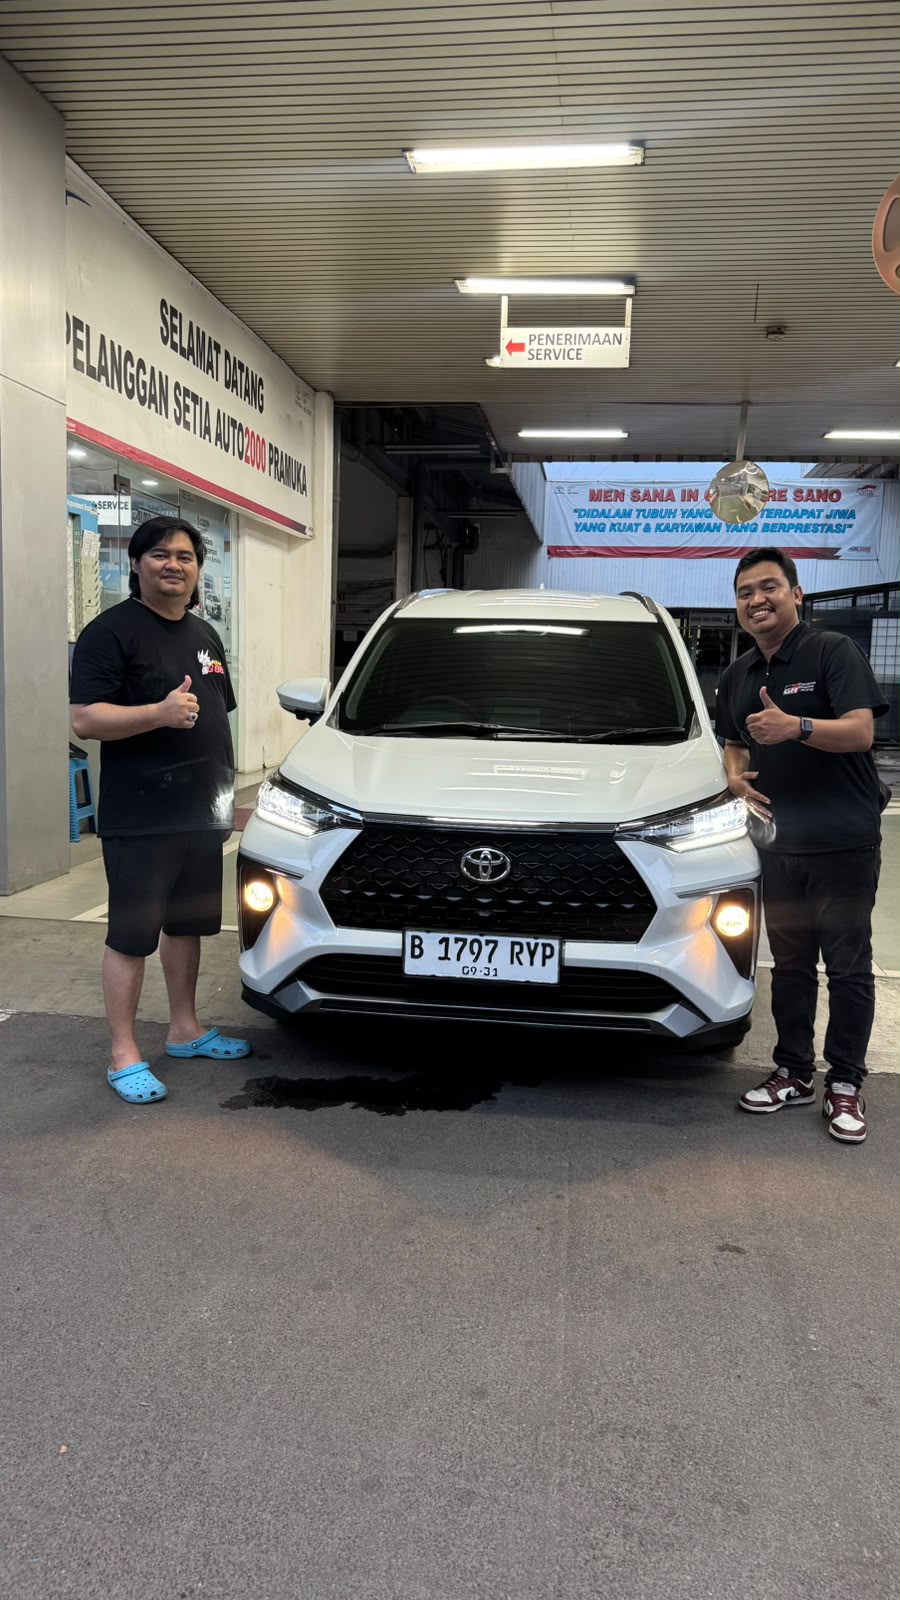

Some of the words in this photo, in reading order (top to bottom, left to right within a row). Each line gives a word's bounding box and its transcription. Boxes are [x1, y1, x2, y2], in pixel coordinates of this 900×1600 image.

[528, 333, 623, 346] PENERIMAAN
[160, 298, 221, 382] SELAMAT
[224, 349, 265, 414] DATANG
[527, 348, 583, 361] SERVICE
[173, 381, 212, 444] SETIA
[215, 408, 266, 474] AUTO2000
[268, 442, 308, 497] PRAMUKA
[588, 488, 625, 503] MEN
[630, 488, 676, 503] SANA
[680, 488, 699, 503] IN
[792, 488, 842, 503] SANO
[97, 500, 129, 510] SERVCE
[635, 508, 678, 519] TUBUH
[680, 508, 713, 519] YANG
[760, 508, 824, 520] TERDAPAT
[825, 508, 856, 520] JIWA
[574, 522, 606, 533] YANG
[609, 522, 642, 533] KUAT
[642, 522, 652, 533] &
[654, 522, 722, 533] KARYAWAN
[725, 522, 759, 533] YANG
[410, 934, 424, 960] B
[437, 935, 499, 964] 1797
[510, 940, 555, 967] RYP
